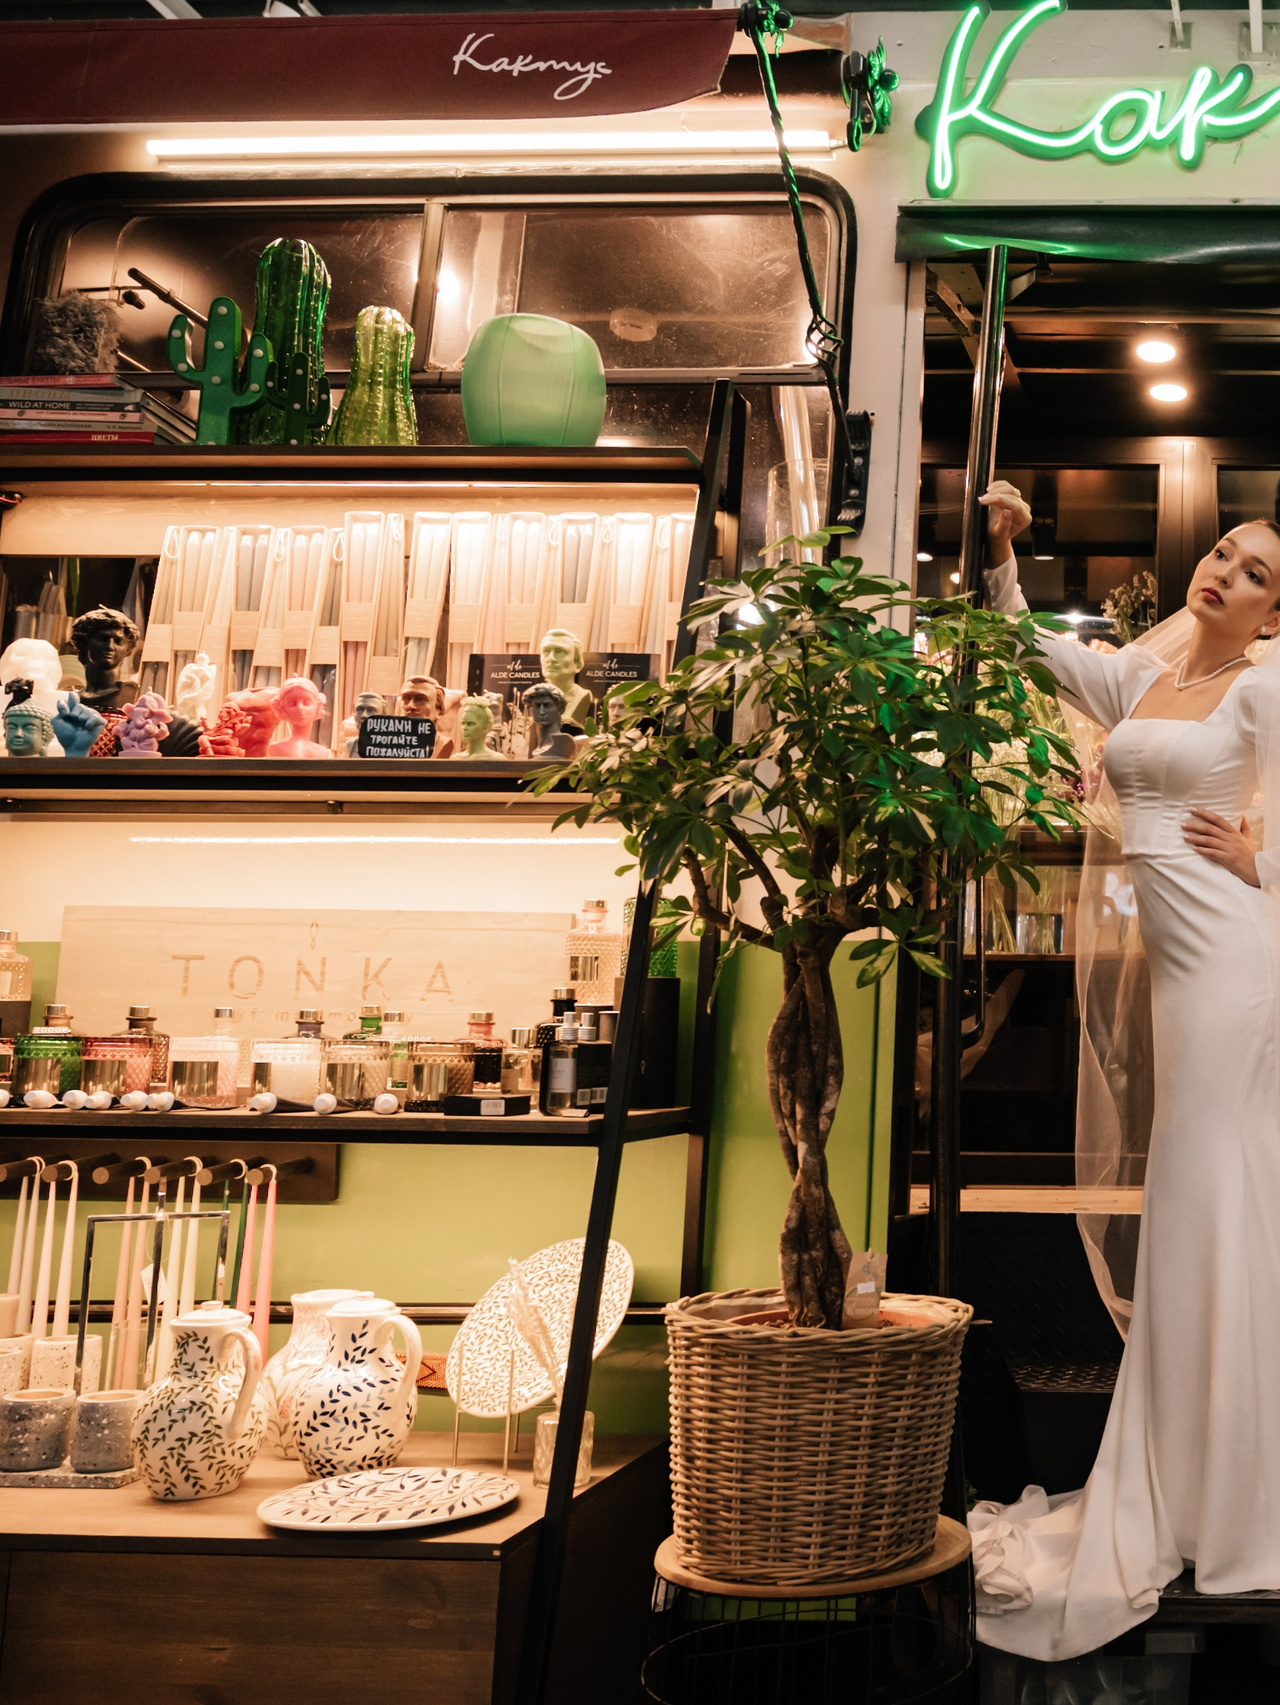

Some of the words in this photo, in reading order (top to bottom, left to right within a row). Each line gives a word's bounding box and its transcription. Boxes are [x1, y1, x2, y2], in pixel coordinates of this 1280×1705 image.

[452, 32, 612, 100] Кактус
[9, 401, 31, 409] WILD
[45, 402, 71, 410] HOME
[490, 671, 508, 679] ALDE
[509, 671, 540, 679] CANDLES
[605, 670, 638, 678] CANDLES
[366, 718, 412, 733] РУКАМИ
[418, 722, 431, 735] НЕ
[370, 734, 418, 746] ТРОГАЙТЕ
[366, 744, 430, 759] ПОЖАЛУЙСТА!
[171, 954, 455, 1001] TONKA
